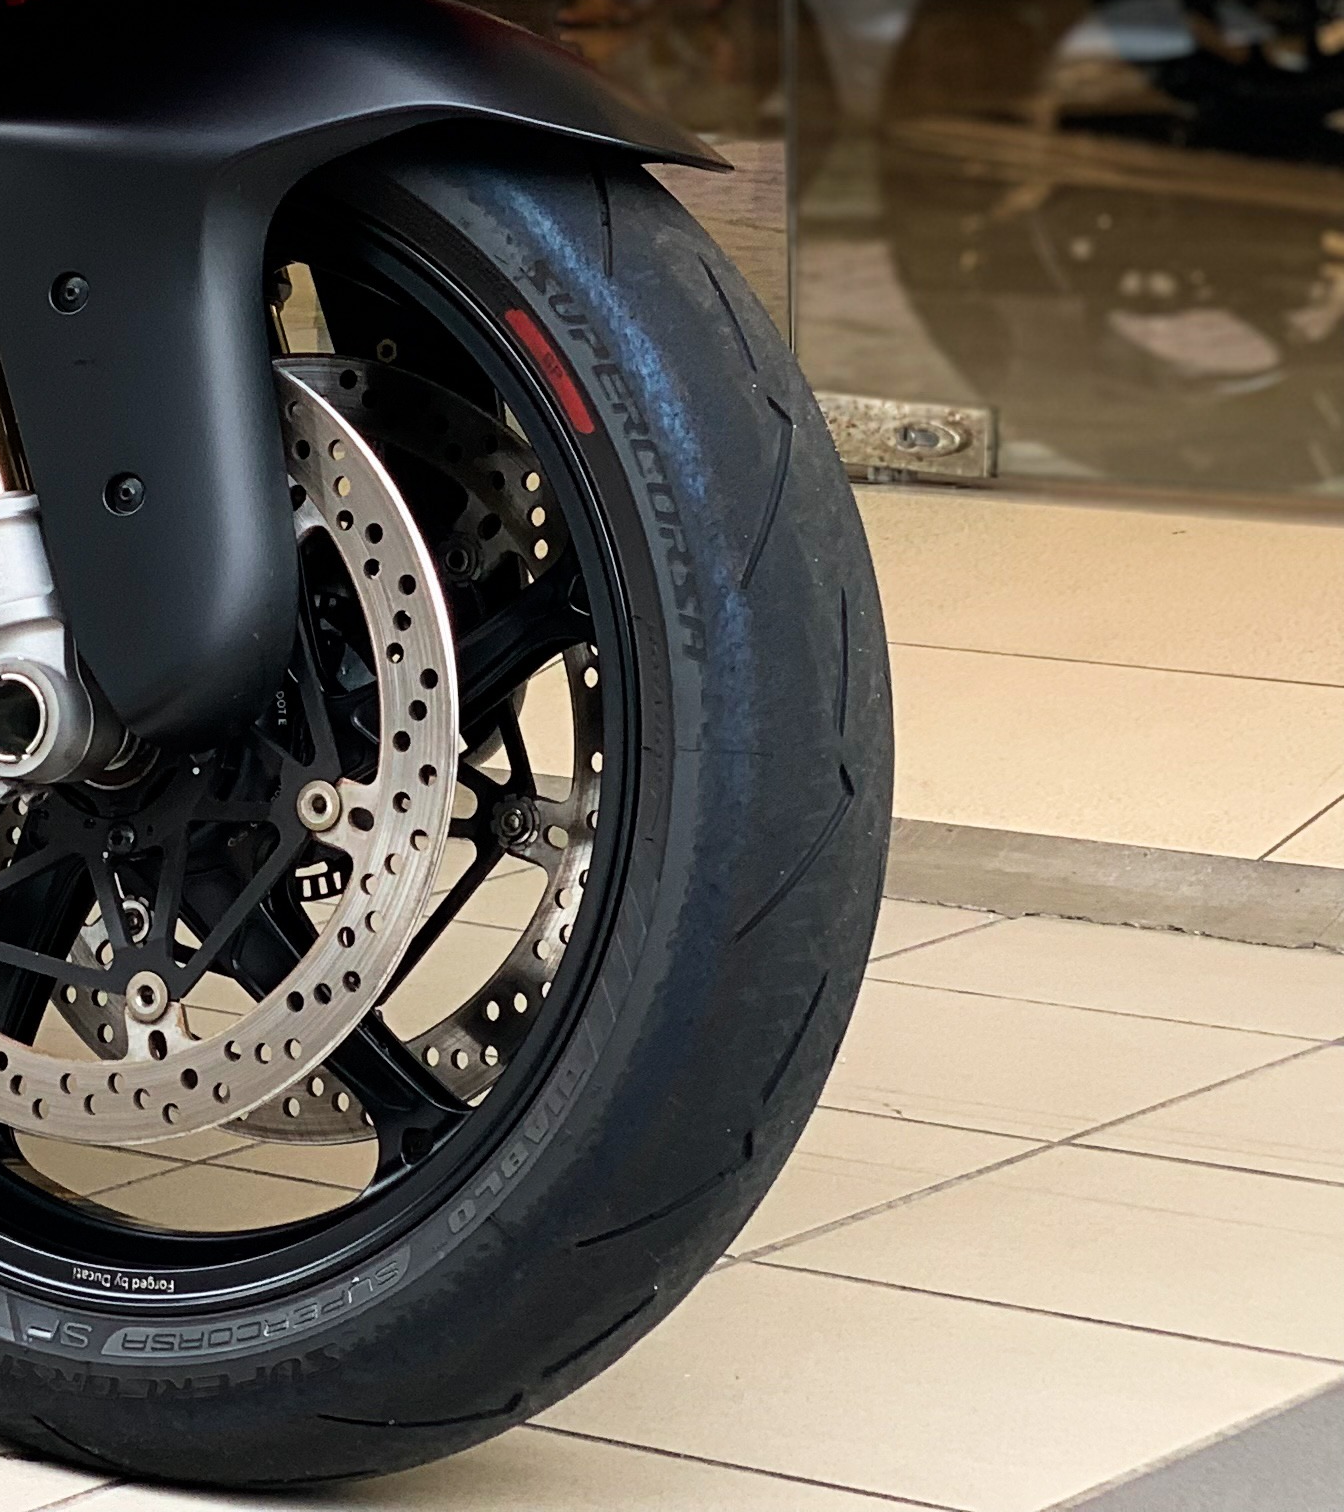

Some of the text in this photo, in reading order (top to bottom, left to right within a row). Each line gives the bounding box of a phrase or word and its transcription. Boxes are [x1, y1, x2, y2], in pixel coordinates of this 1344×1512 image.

[20, 1066, 588, 1352] DIABLO SUPERCORSA SP
[71, 1265, 176, 1294] Forged by Ducati
